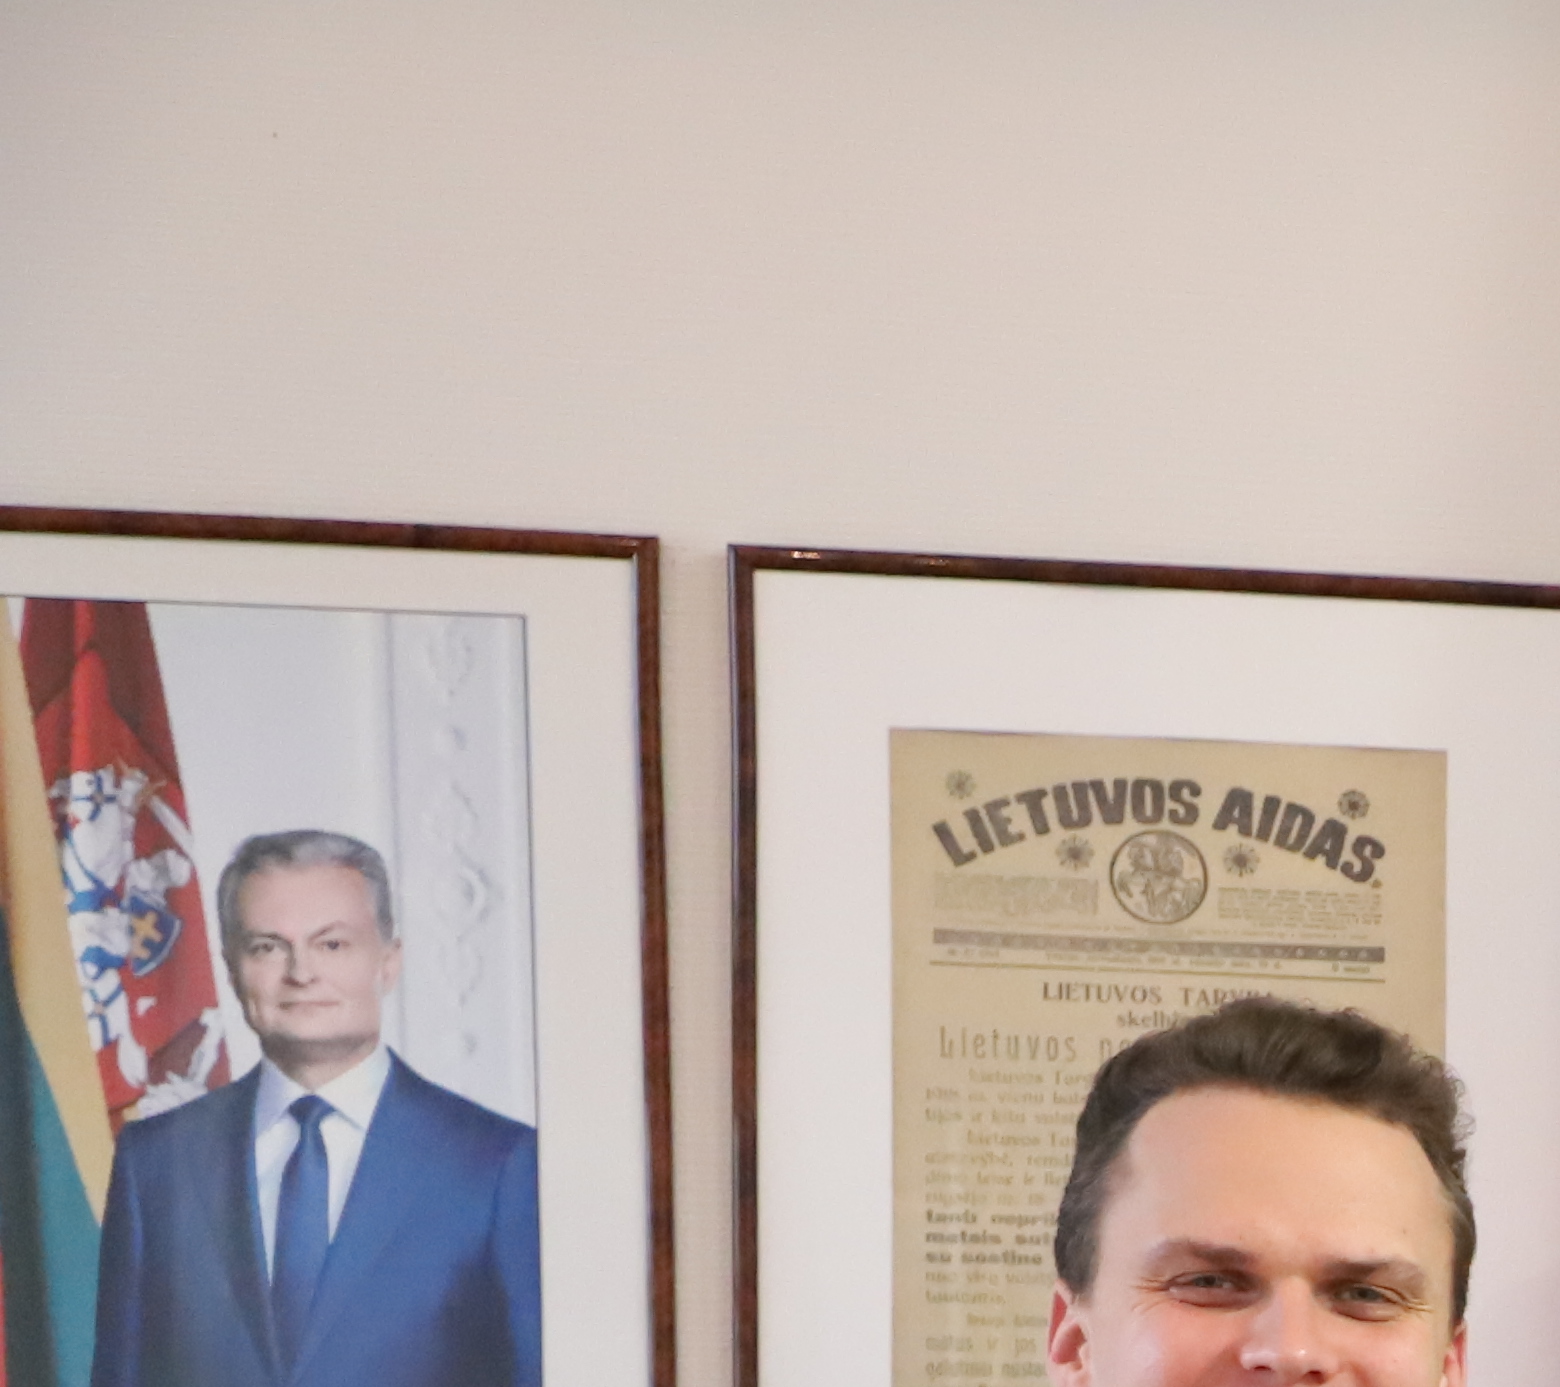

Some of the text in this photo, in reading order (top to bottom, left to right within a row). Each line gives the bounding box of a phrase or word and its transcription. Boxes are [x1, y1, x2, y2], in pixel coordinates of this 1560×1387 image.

[931, 778, 1201, 868] LIETUVOS
[1041, 981, 1163, 1005] LIETUVOS
[938, 1024, 1077, 1063] Lietuvos
